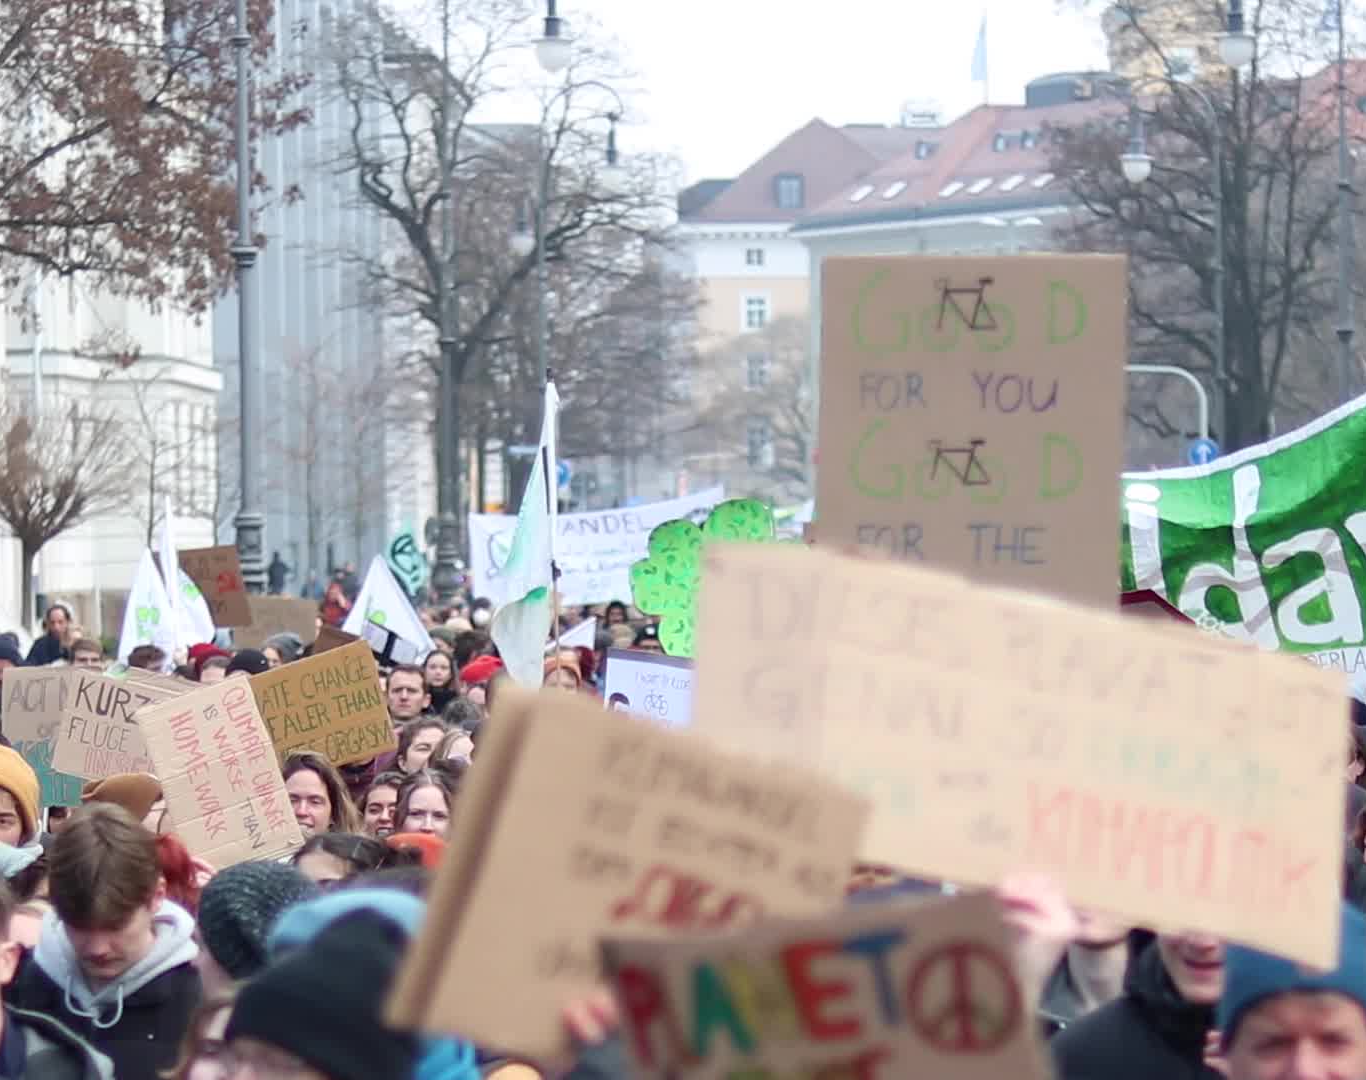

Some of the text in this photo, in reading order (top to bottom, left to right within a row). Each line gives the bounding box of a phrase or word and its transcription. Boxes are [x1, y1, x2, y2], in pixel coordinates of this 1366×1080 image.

[858, 370, 1059, 414] FOR YOU
[558, 512, 651, 536] ANDEL
[855, 522, 1048, 565] FOR THE
[7, 677, 56, 713] ACT
[300, 655, 372, 700] CHANGE
[332, 684, 382, 719] THAN
[219, 687, 288, 833] CLIMATE CHANGE
[325, 719, 396, 763] ORGASM
[203, 703, 267, 850] IS WORSE THAN
[617, 928, 909, 1072] PLANET
